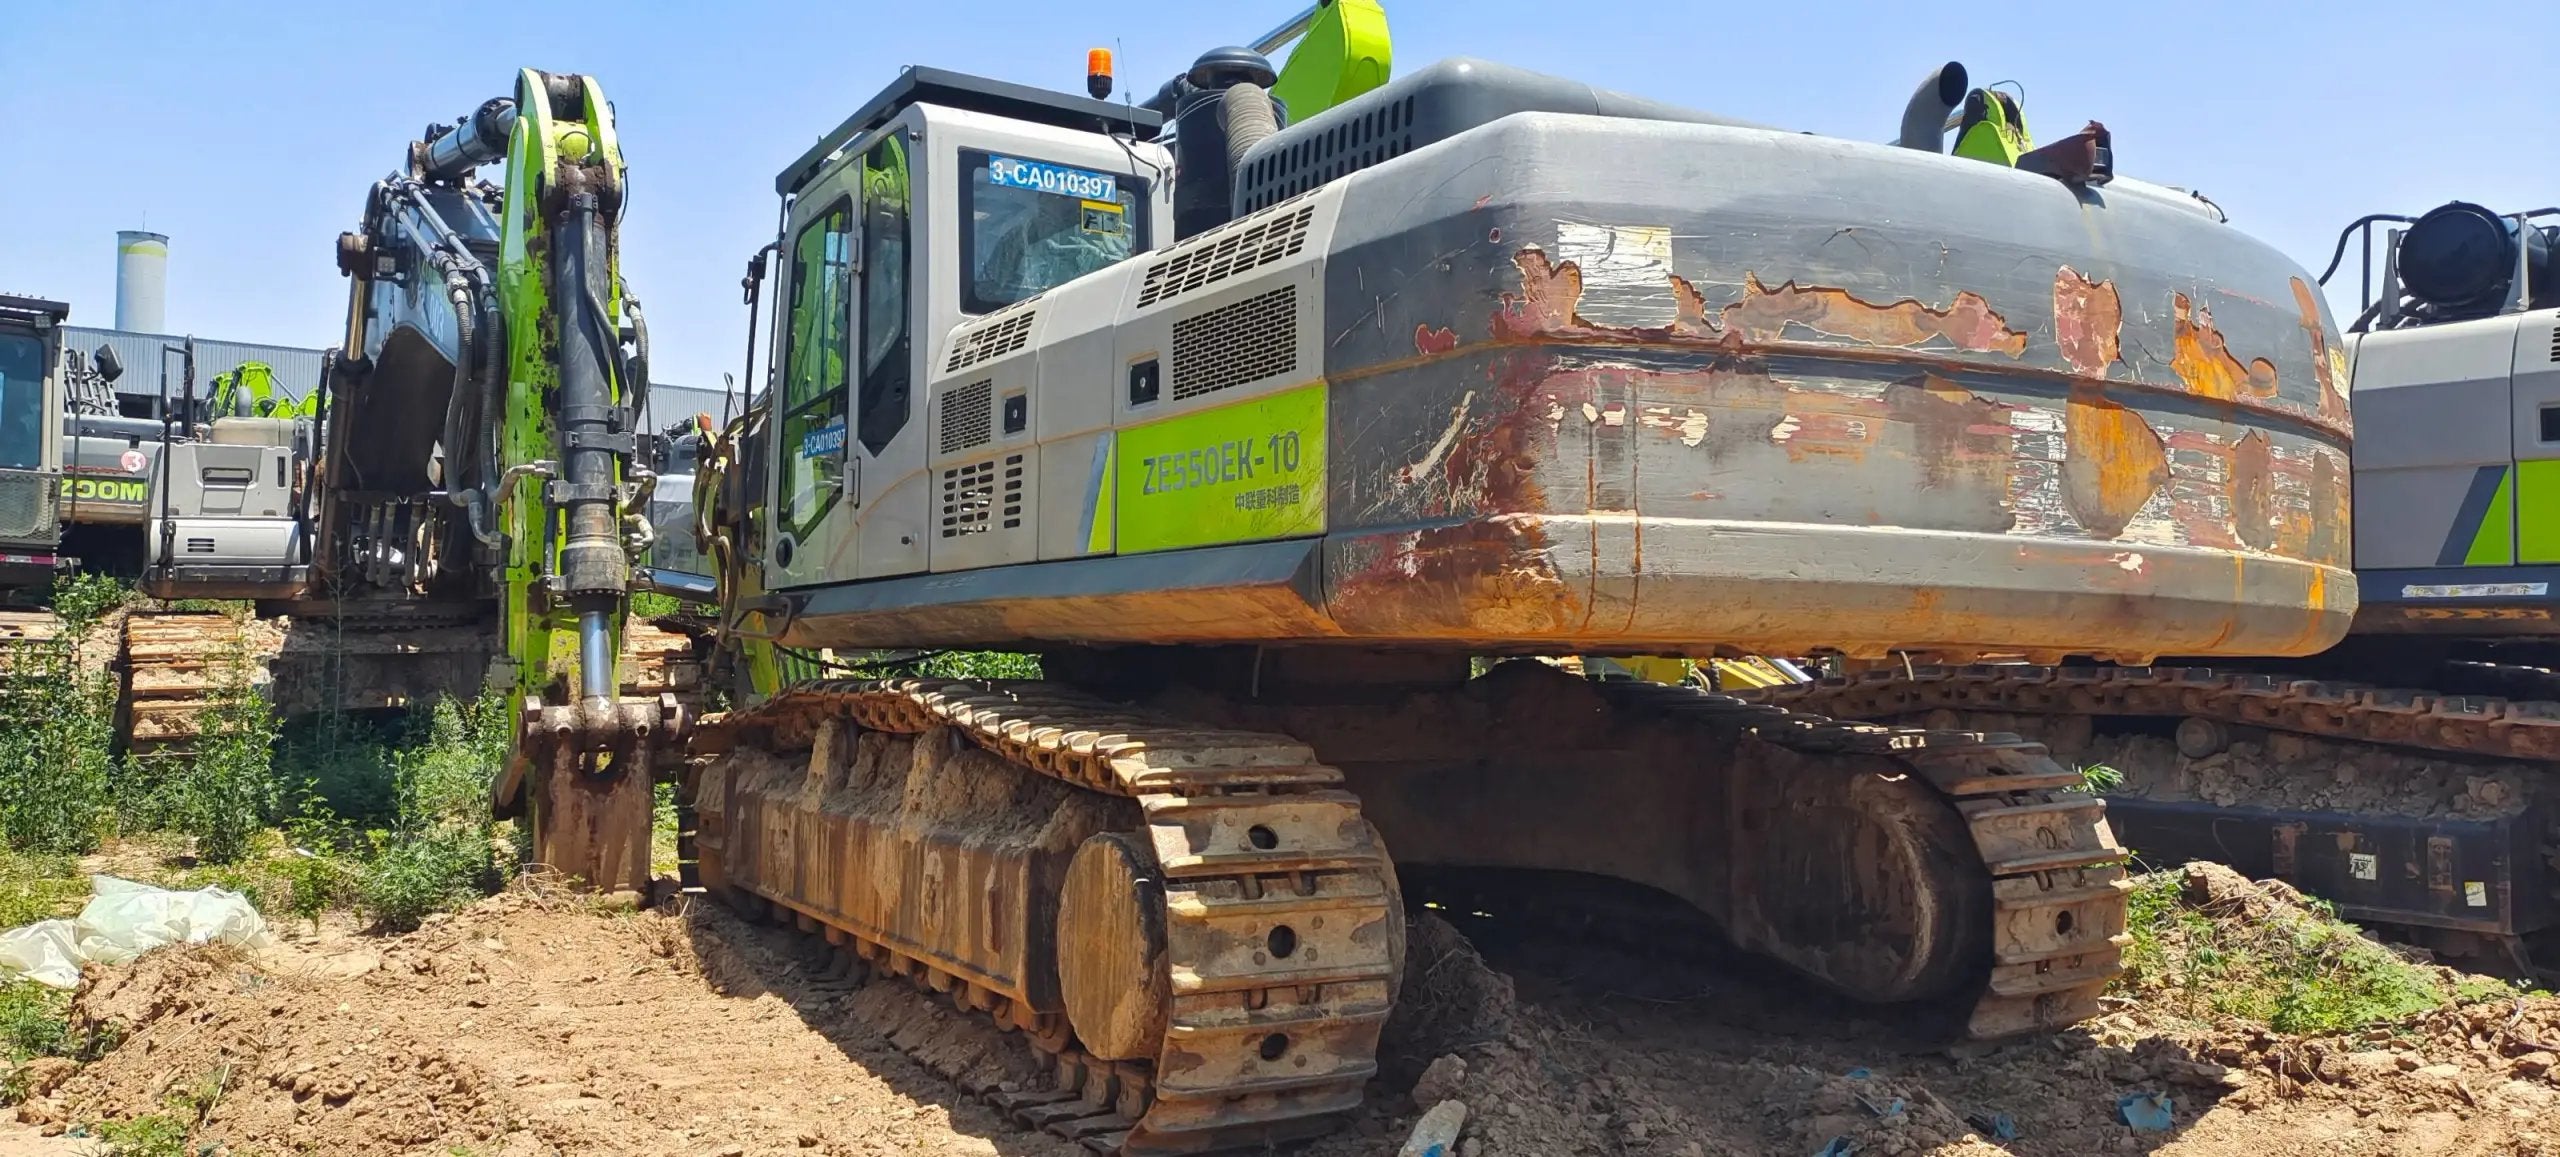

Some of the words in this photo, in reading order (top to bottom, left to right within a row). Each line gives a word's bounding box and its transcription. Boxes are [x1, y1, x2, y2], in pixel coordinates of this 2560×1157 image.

[992, 160, 1113, 199] 3-CA010397
[126, 452, 143, 471] 3
[1142, 430, 1300, 496] ZE550EK-10
[1234, 483, 1300, 512] 中联重科制造
